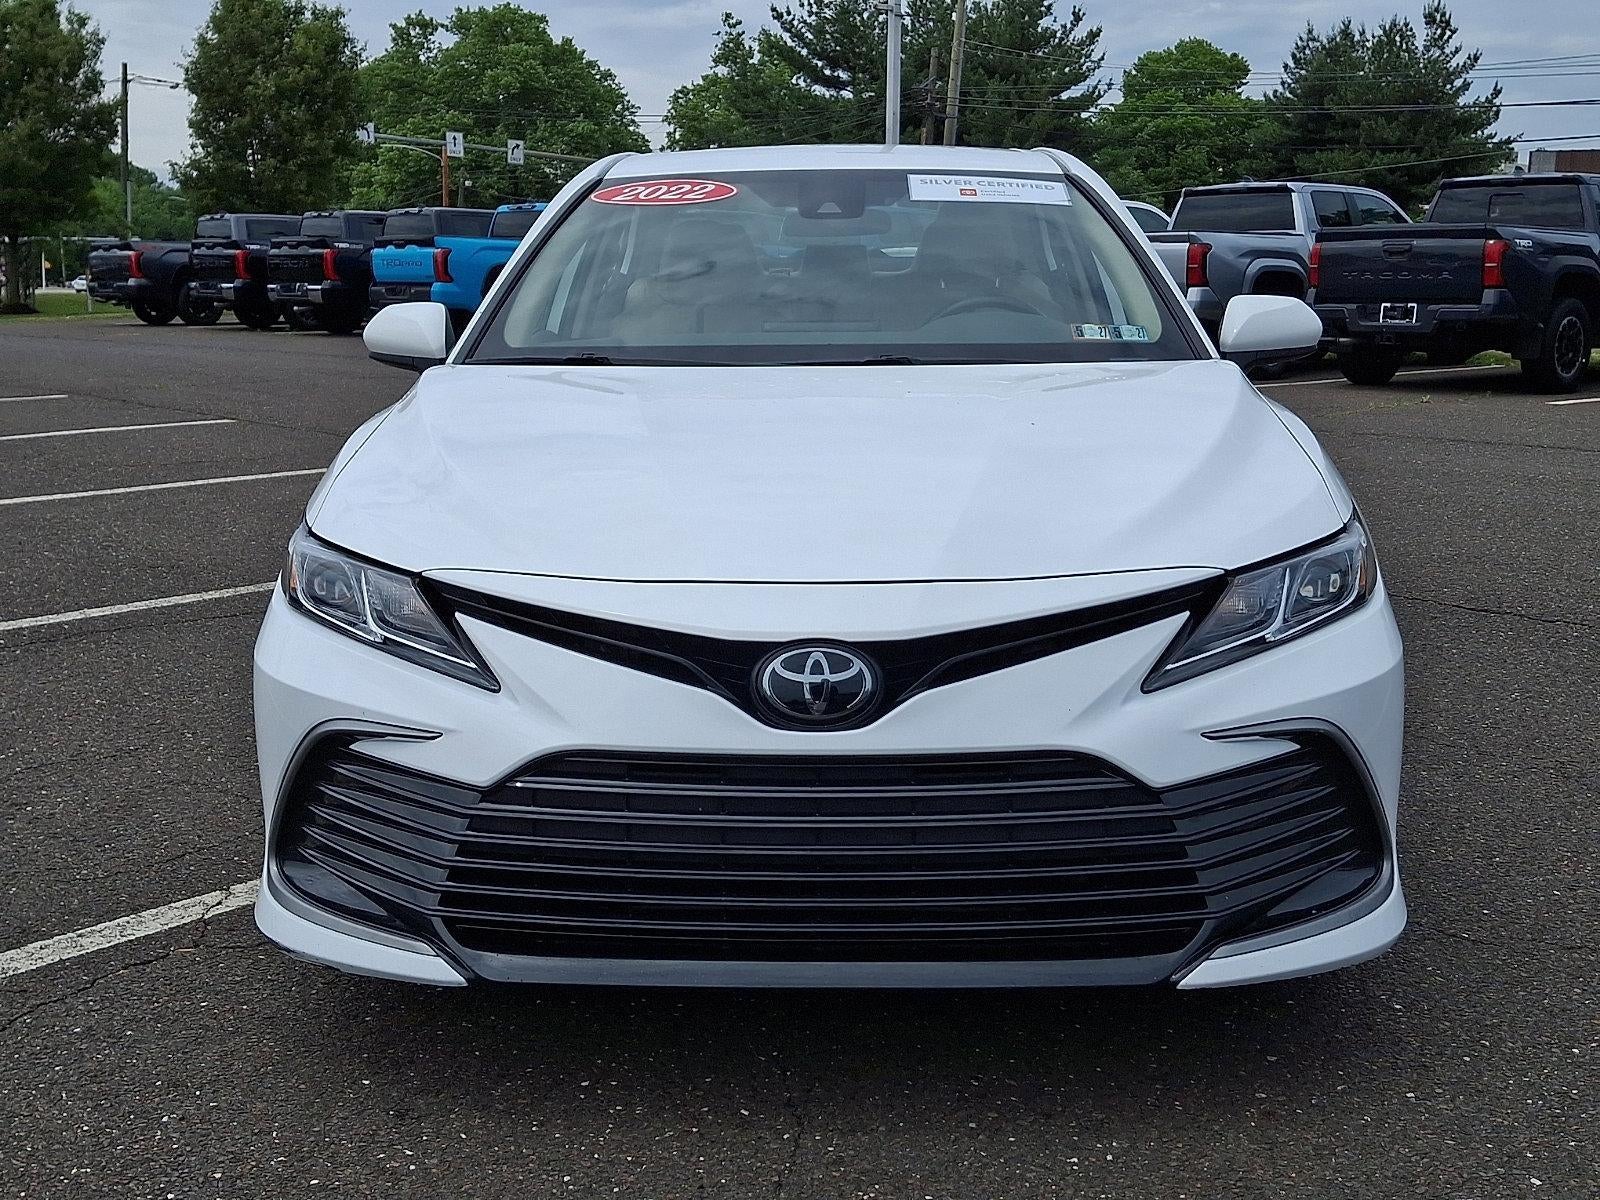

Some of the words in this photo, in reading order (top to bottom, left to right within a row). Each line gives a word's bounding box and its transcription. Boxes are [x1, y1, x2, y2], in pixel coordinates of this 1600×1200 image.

[919, 178, 972, 187] SILVER
[976, 179, 1056, 191] CERTIFIED
[611, 184, 716, 201] 2022
[1514, 239, 1533, 248] TRD
[1342, 271, 1453, 279] TACOMA
